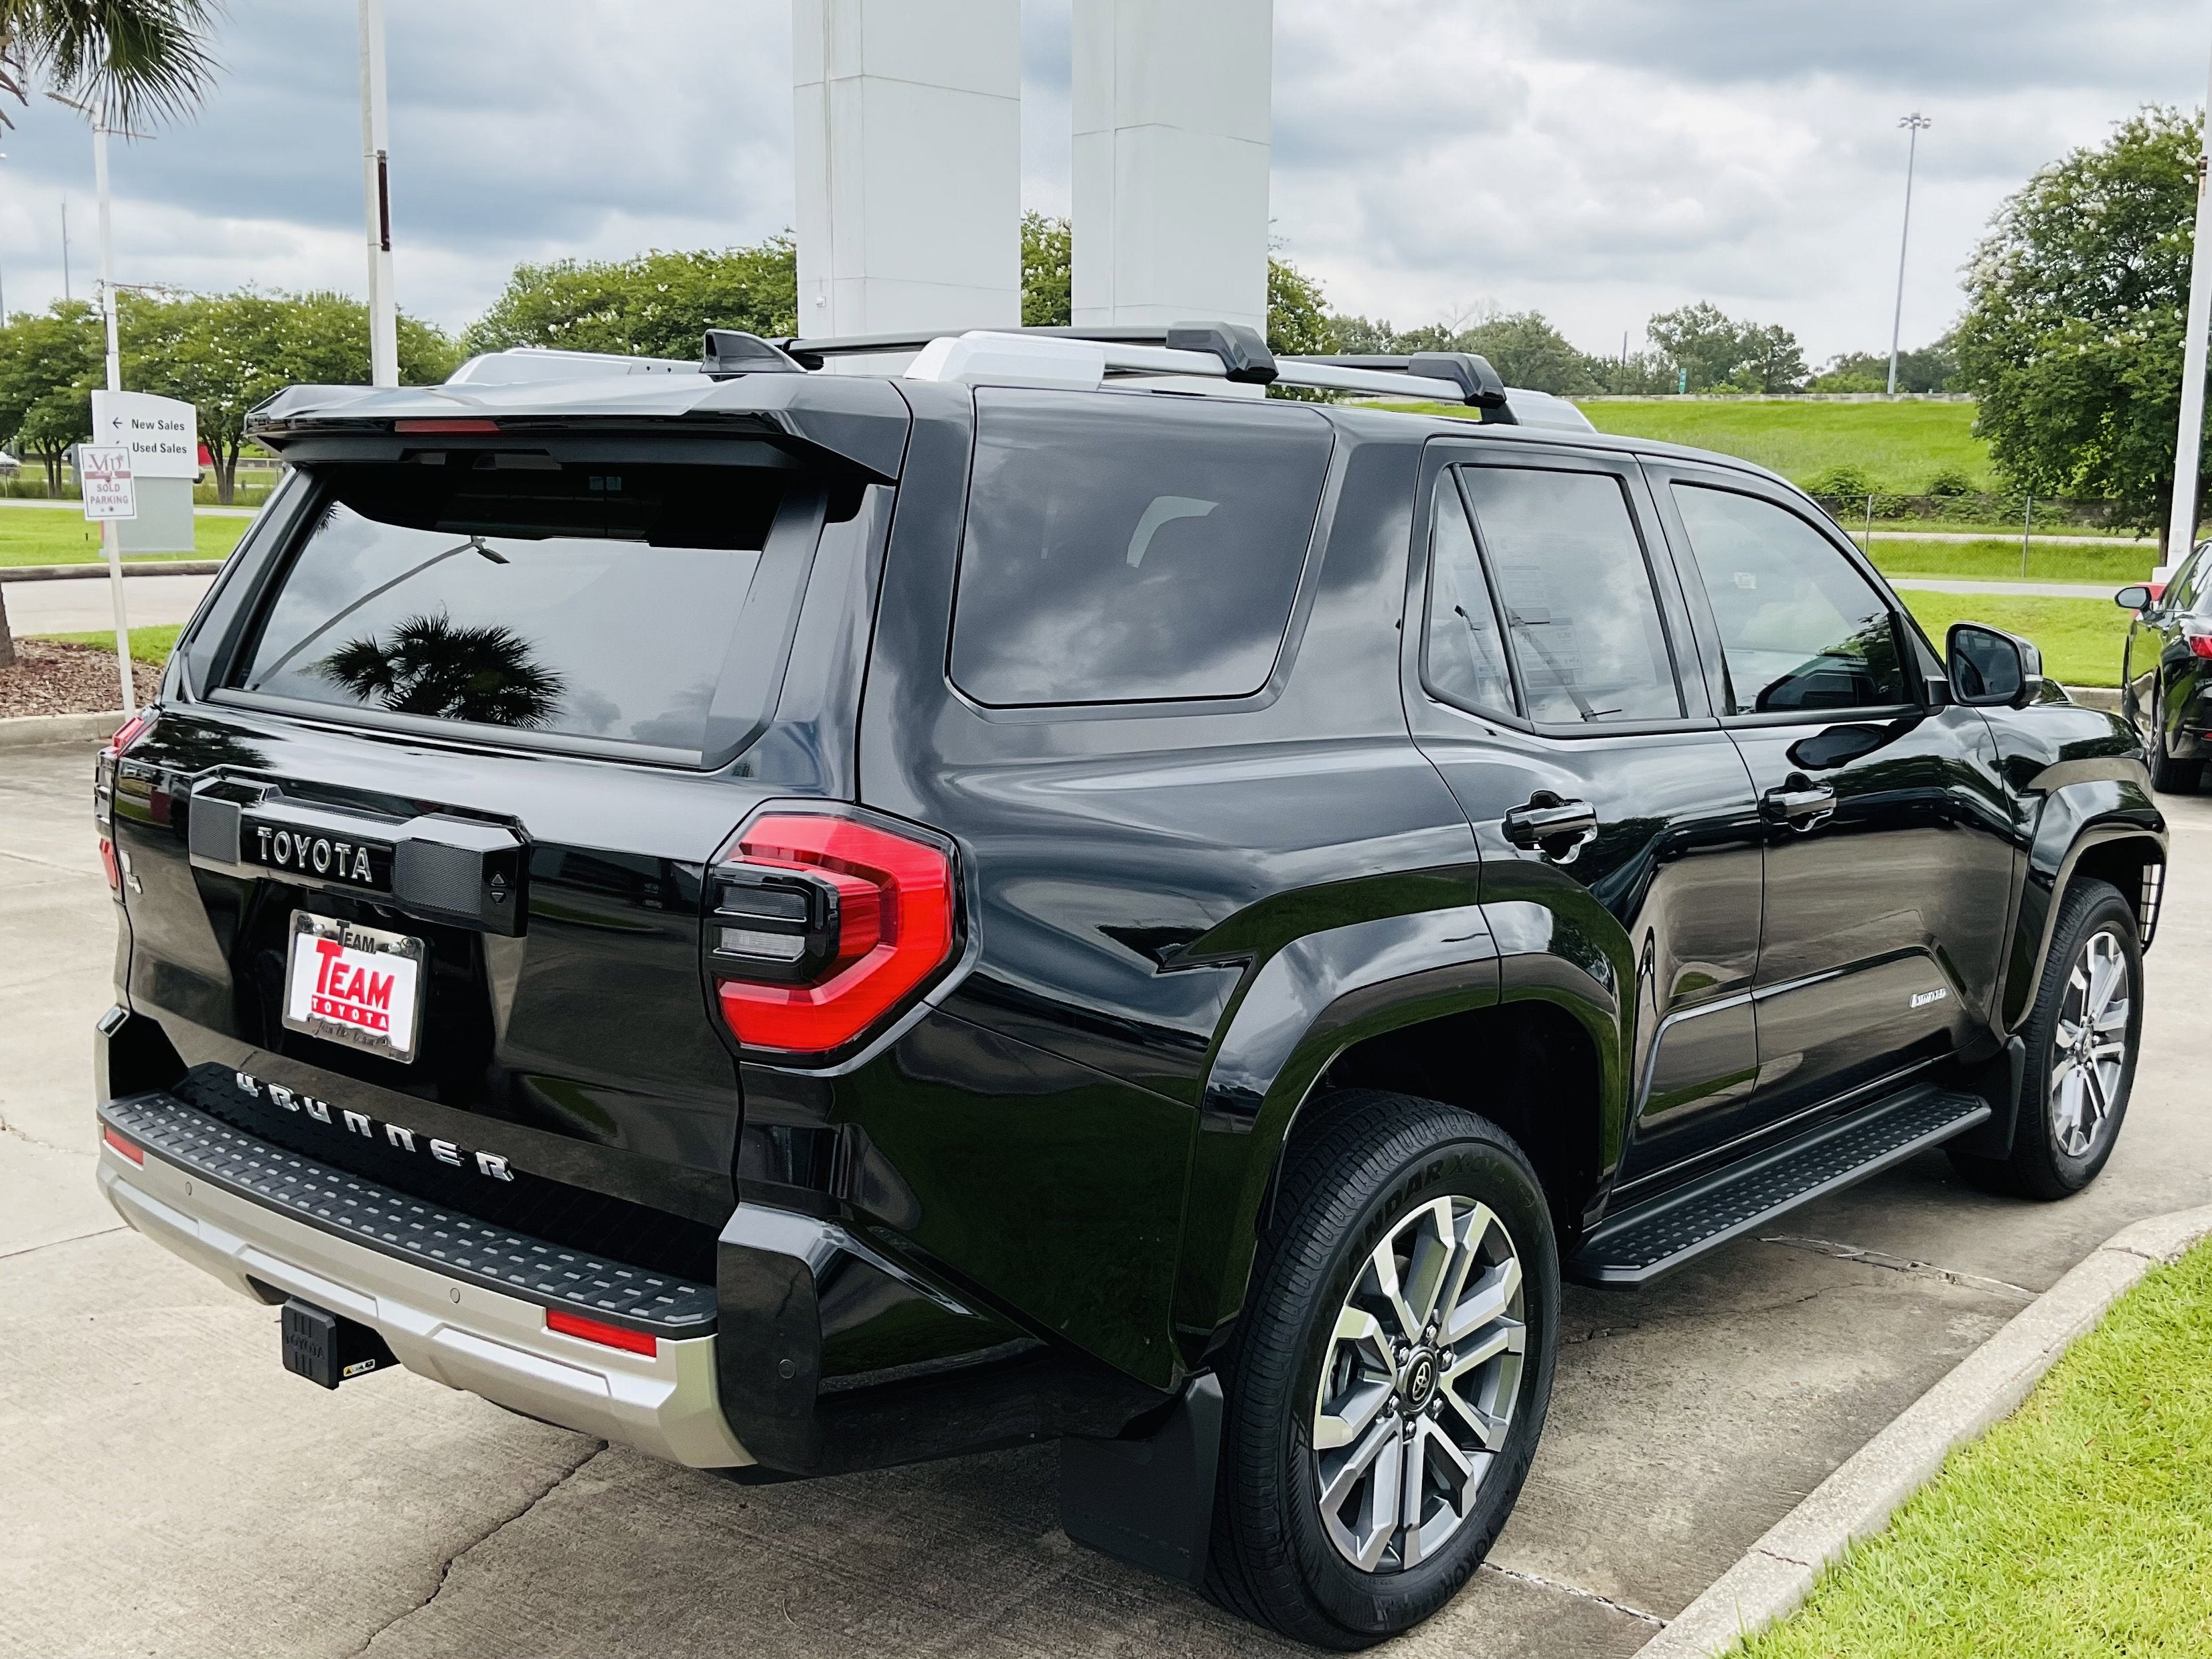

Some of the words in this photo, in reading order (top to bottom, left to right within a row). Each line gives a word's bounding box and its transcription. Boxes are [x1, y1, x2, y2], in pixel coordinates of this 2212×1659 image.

[131, 418, 154, 430] New
[157, 420, 185, 431] Sales
[133, 442, 157, 453] Used
[160, 443, 187, 454] Sales
[90, 495, 129, 504] PARKING
[96, 483, 121, 493] SOLD
[257, 825, 373, 882] TOYOTA
[316, 938, 395, 1010] TEAM
[312, 998, 388, 1029] TOYOTA
[236, 1071, 514, 1182] 4RUNNER
[285, 1332, 325, 1360] TOYOTA
